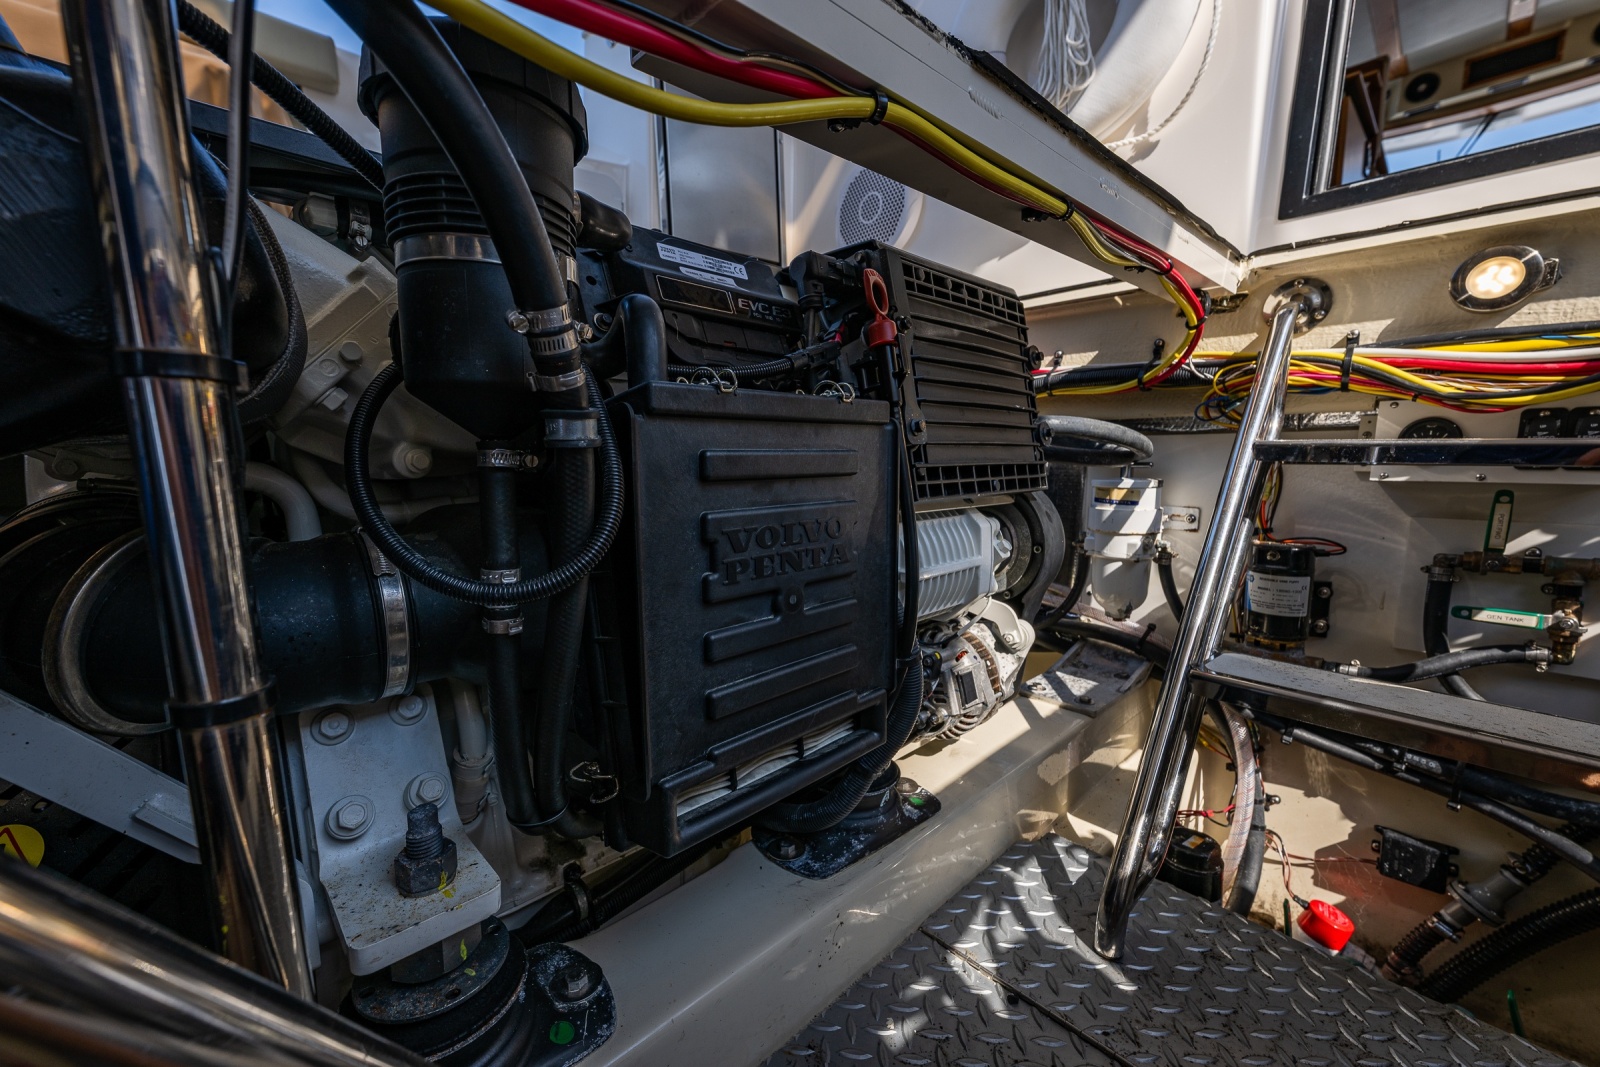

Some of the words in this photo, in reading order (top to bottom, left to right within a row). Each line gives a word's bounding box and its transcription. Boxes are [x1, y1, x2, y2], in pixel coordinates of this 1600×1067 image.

[737, 297, 770, 314] EVC
[721, 517, 848, 553] VOLVO
[722, 543, 851, 586] PENTA
